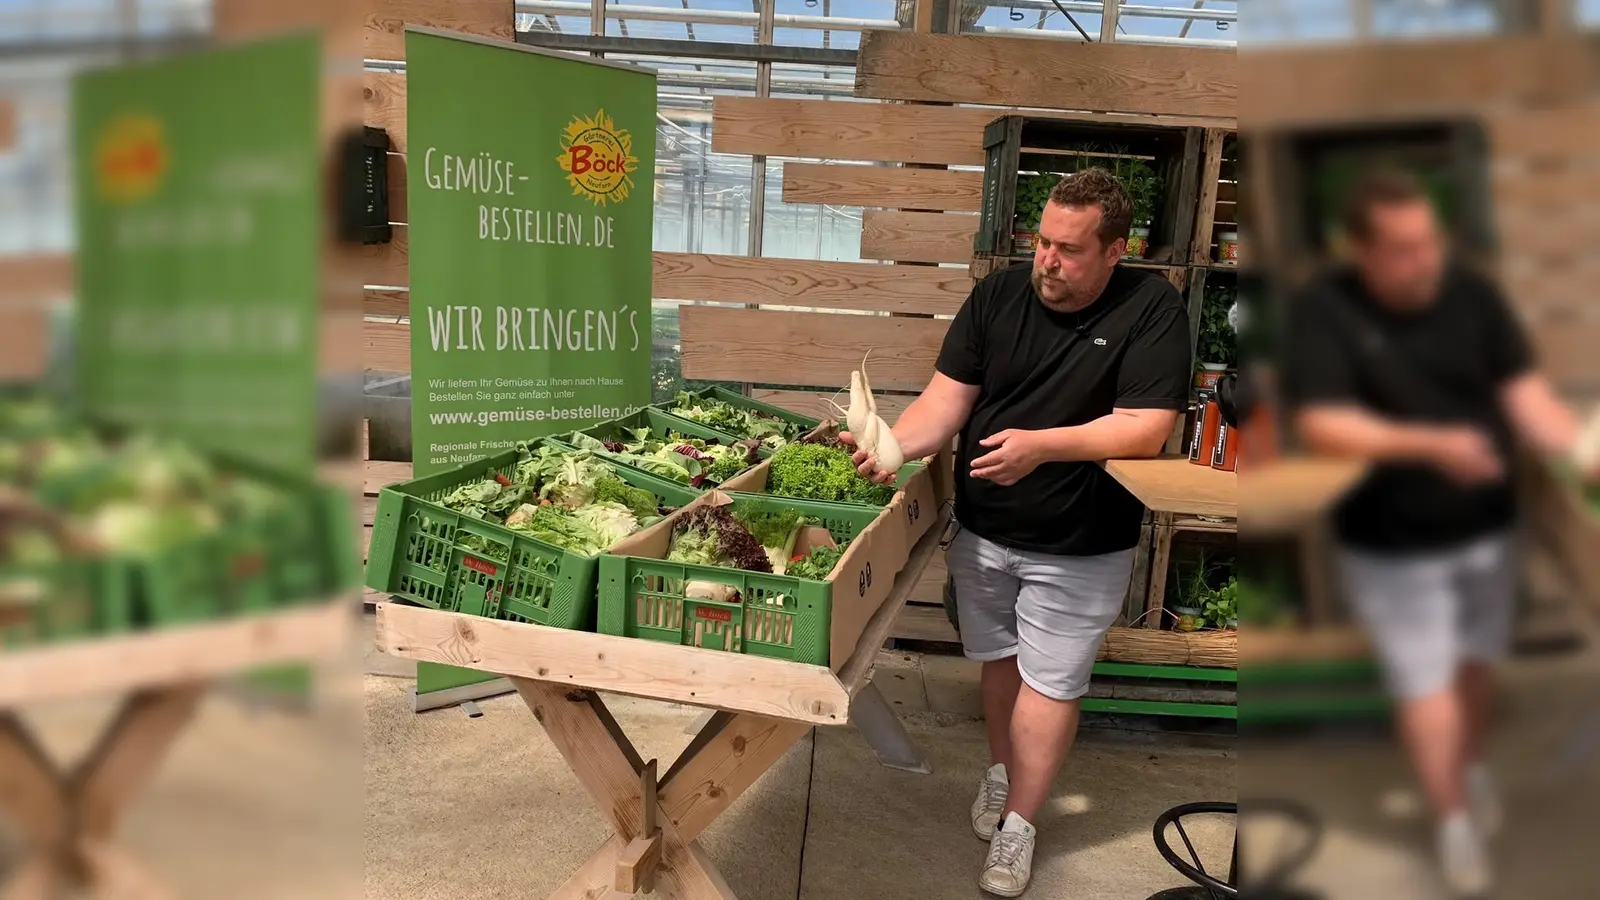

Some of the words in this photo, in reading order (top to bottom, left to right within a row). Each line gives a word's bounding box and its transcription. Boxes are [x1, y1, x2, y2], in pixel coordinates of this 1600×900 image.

[584, 133, 614, 147] Gärtnerei
[569, 145, 626, 175] Böck
[478, 205, 615, 248] BESTELLEN.DE
[428, 305, 485, 352] WIR
[429, 379, 446, 388] Wir
[480, 378, 492, 387] Ihr
[495, 377, 534, 387] Gemüse
[549, 377, 573, 386] Ihnen
[575, 377, 595, 386] nach
[429, 391, 473, 402] Bestellen
[476, 390, 491, 400] Sie
[494, 391, 516, 402] ganz
[519, 390, 551, 399] einfach
[554, 390, 575, 398] unter
[430, 441, 477, 453] Regionale
[480, 439, 515, 448] Frische
[430, 456, 447, 464] aus
